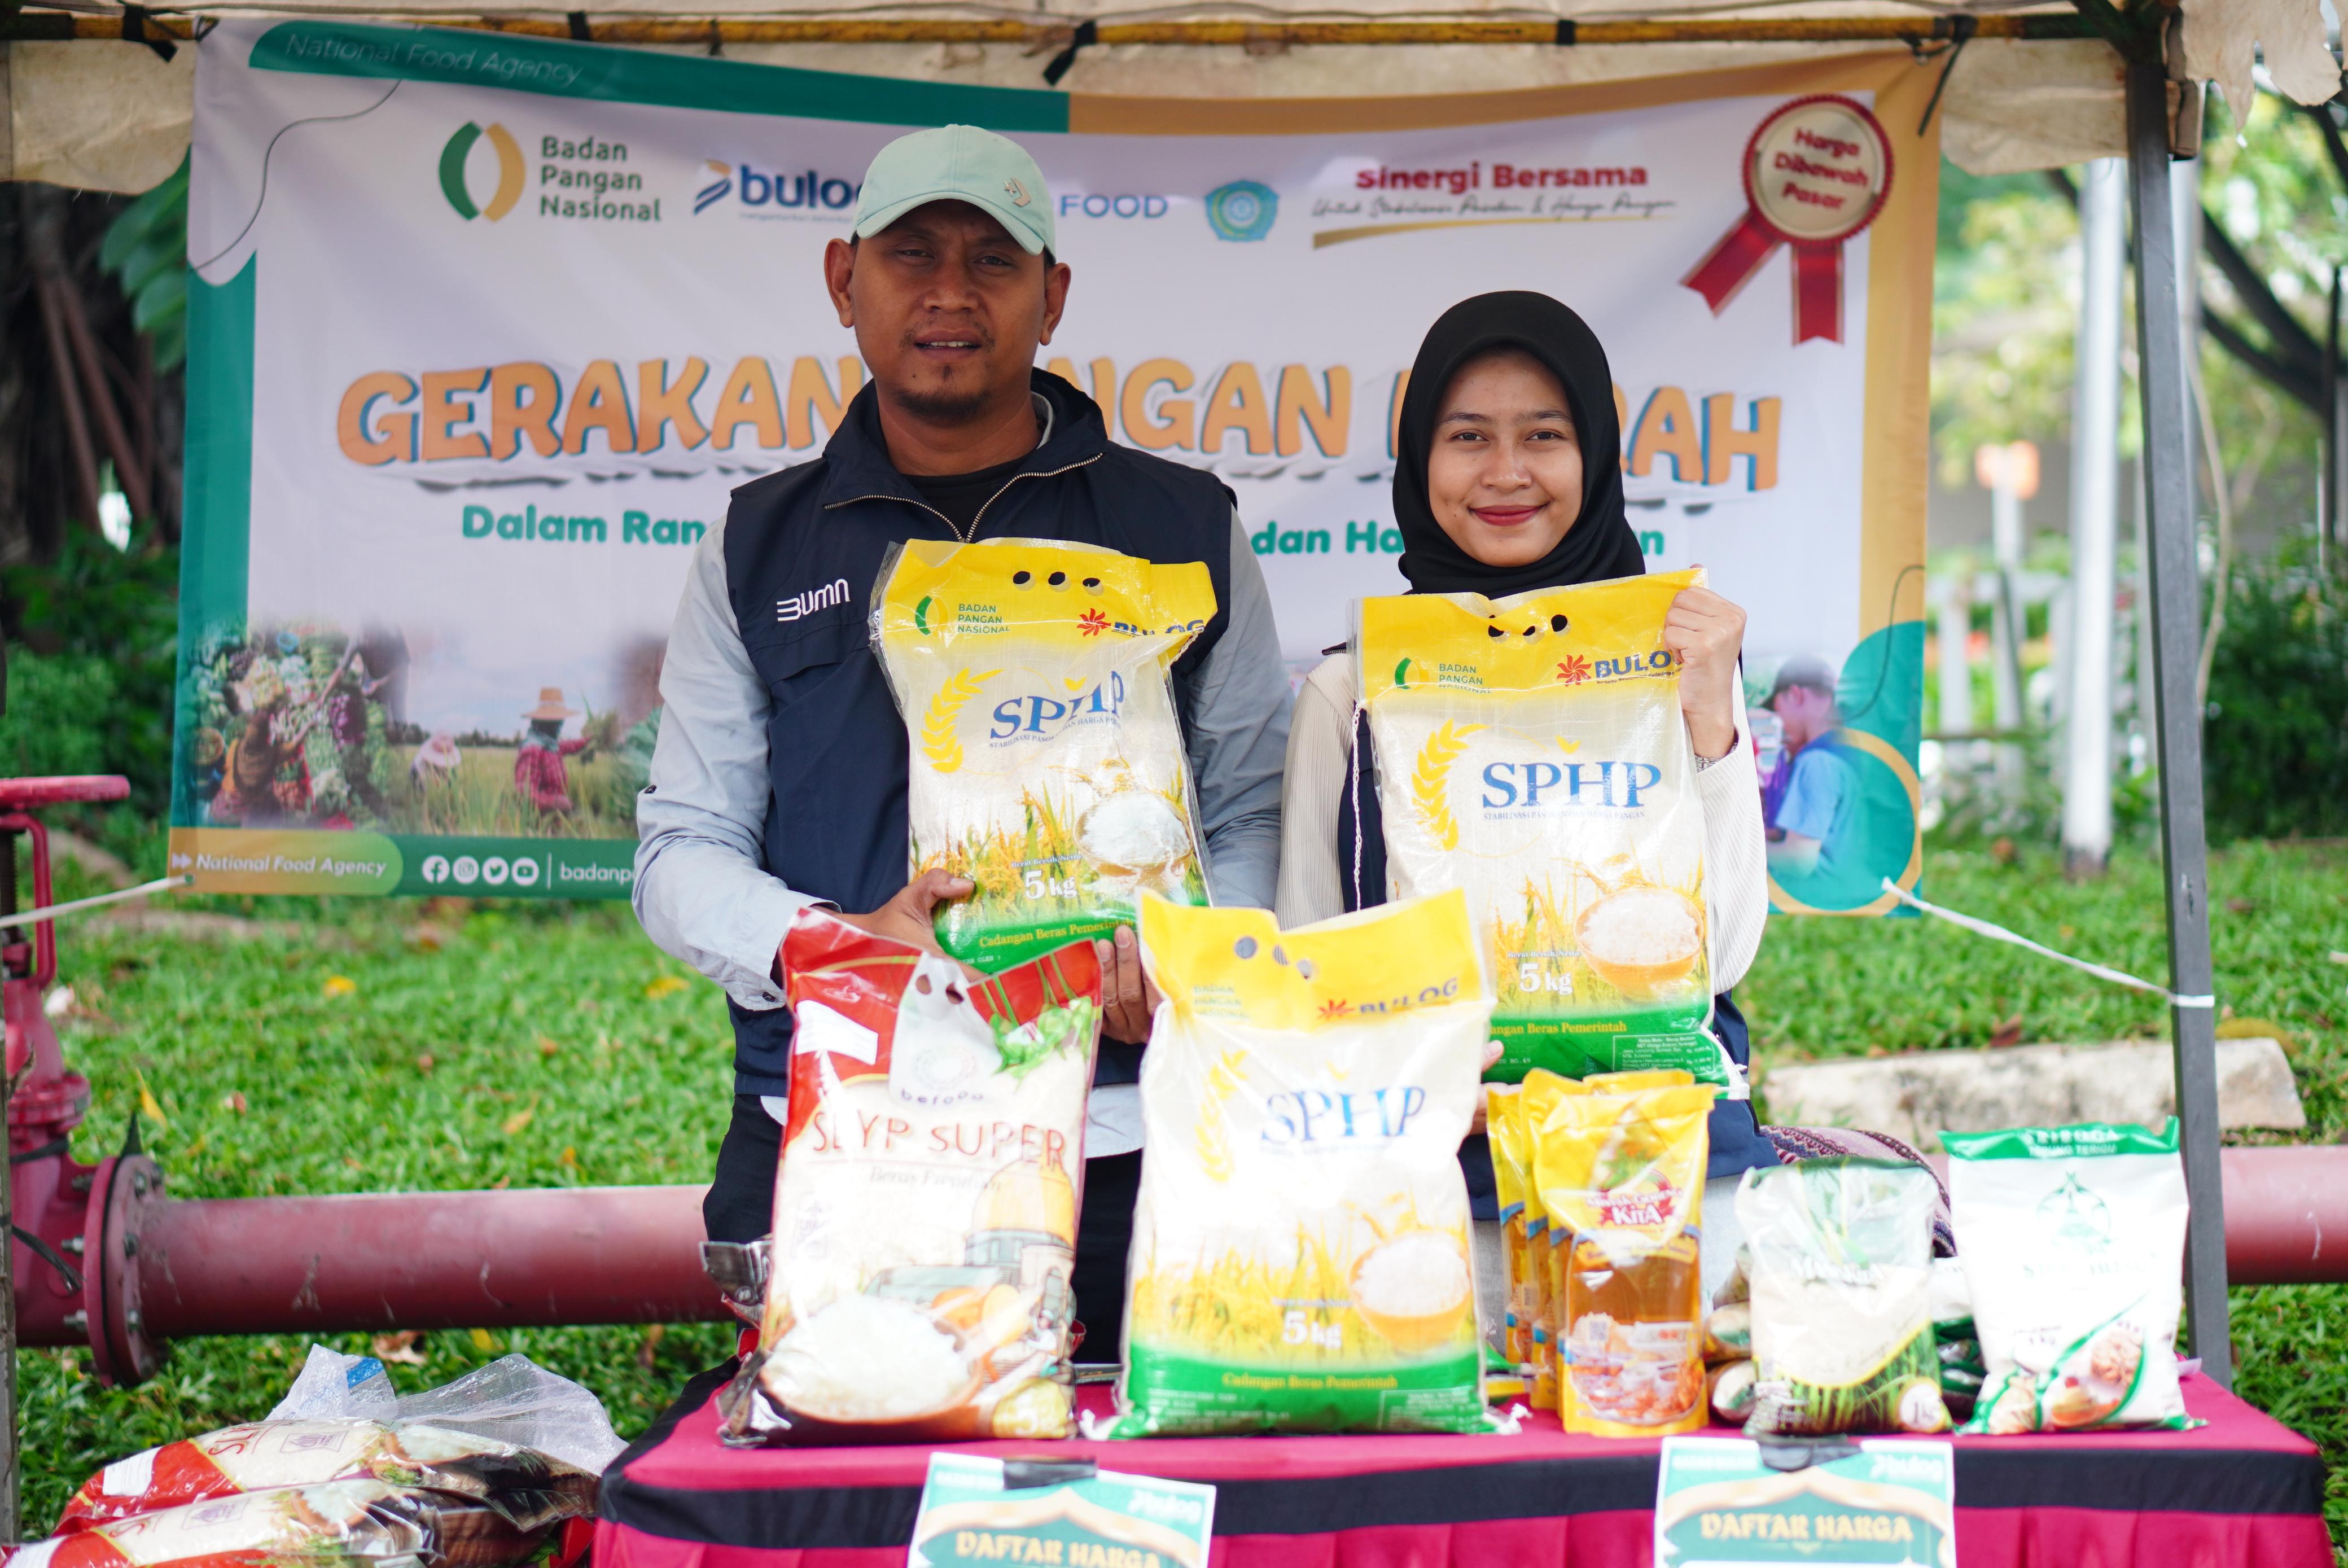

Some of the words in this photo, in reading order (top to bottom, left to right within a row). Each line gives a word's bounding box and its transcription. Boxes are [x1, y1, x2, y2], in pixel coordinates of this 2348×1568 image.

[286, 33, 398, 62] National
[406, 43, 478, 71] Food
[480, 51, 585, 87] Agency
[541, 135, 628, 162] Badan
[1794, 126, 1861, 159] Harga
[540, 165, 642, 192] Pangan
[1492, 163, 1648, 189] Bersama
[1774, 151, 1869, 187] Dibawah
[540, 194, 661, 222] Nasional
[1060, 195, 1168, 218] FOOD
[1782, 182, 1846, 209] Pasar
[337, 355, 865, 467] GERAKAN
[1046, 357, 1352, 458] NGAN
[461, 503, 607, 543] Dalam
[623, 509, 712, 546] Ran
[1251, 520, 1330, 555] dan
[958, 603, 996, 613] BADAN
[958, 614, 1002, 624] PANGAN
[958, 625, 1010, 633] NASIONAL
[1439, 663, 1477, 673] BADAN
[1595, 650, 1673, 678] BULO
[1439, 674, 1483, 685] PANGAN
[1077, 715, 1105, 726] HARGA
[1482, 761, 1662, 808] SPHP
[196, 853, 270, 872] National
[273, 854, 317, 874] Food
[321, 856, 387, 878] Agency
[1024, 870, 1045, 900] 5
[1049, 875, 1078, 899] kg
[979, 931, 1033, 948] Cadangan
[1036, 927, 1067, 940] Beras
[1519, 962, 1540, 992] 5
[1545, 970, 1573, 995] kg
[1490, 1024, 1524, 1036] angan
[1527, 1022, 1559, 1034] Beras
[1562, 1020, 1627, 1033] Pemerintah
[1262, 1085, 1426, 1143] SPHP
[927, 1121, 1066, 1167] SUPER
[1282, 1310, 1308, 1344] 5
[1310, 1321, 1342, 1350] kg
[1222, 1372, 1286, 1390] Cadangan
[1288, 1374, 1324, 1389] Beras
[1326, 1374, 1398, 1389] Pemerintah
[1700, 1513, 1811, 1541] DAFTAR
[1815, 1515, 1914, 1543] HARGA
[956, 1531, 1063, 1564] DAFTAR
[1068, 1542, 1161, 1568] HARGA
